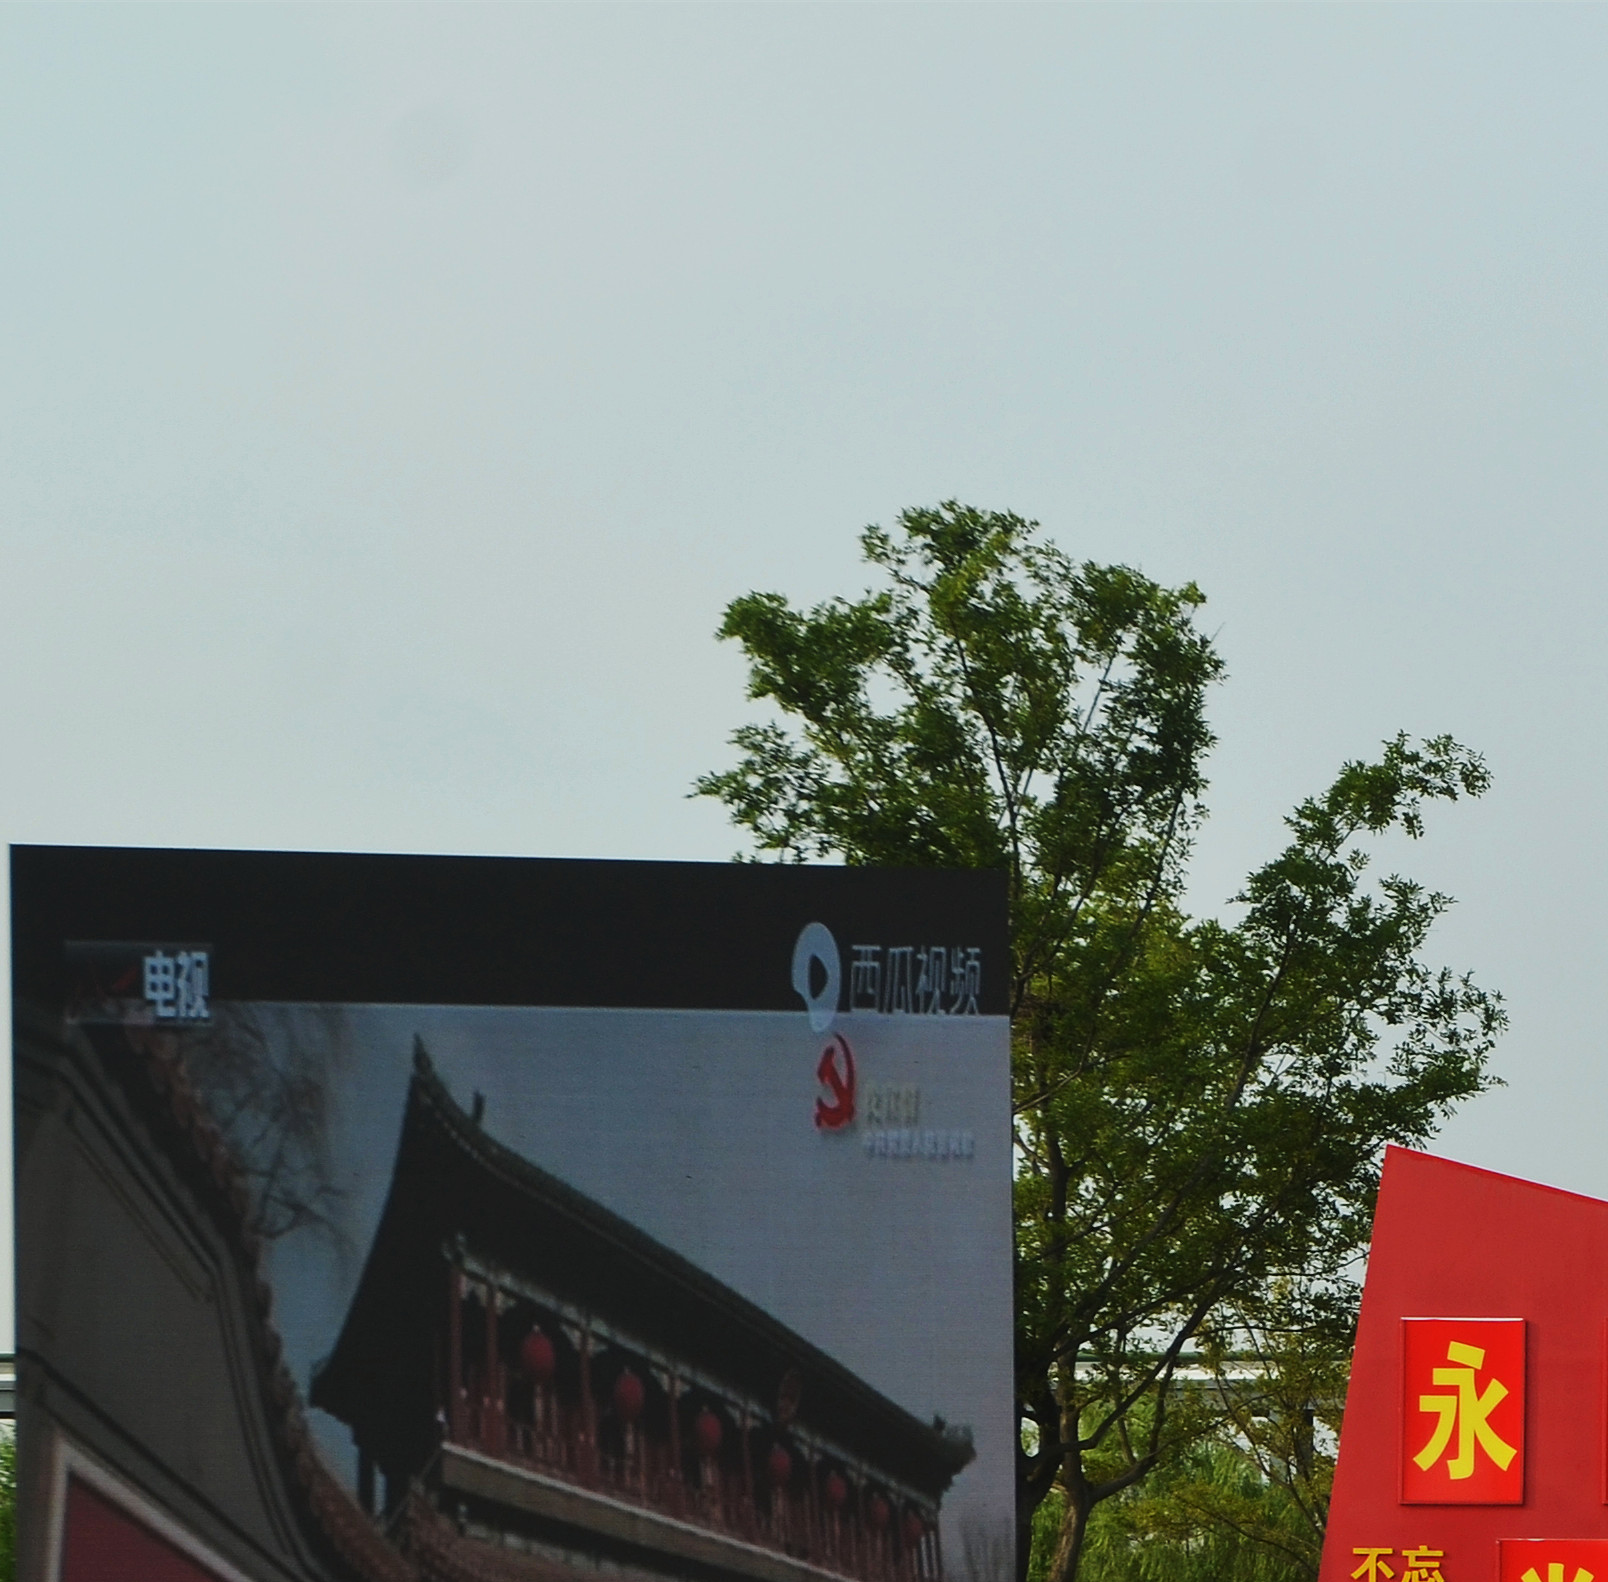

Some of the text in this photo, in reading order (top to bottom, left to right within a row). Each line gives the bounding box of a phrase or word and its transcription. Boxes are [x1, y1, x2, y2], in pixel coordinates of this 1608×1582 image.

[144, 950, 209, 1018] 电视
[850, 945, 981, 1015] 西瓜视频
